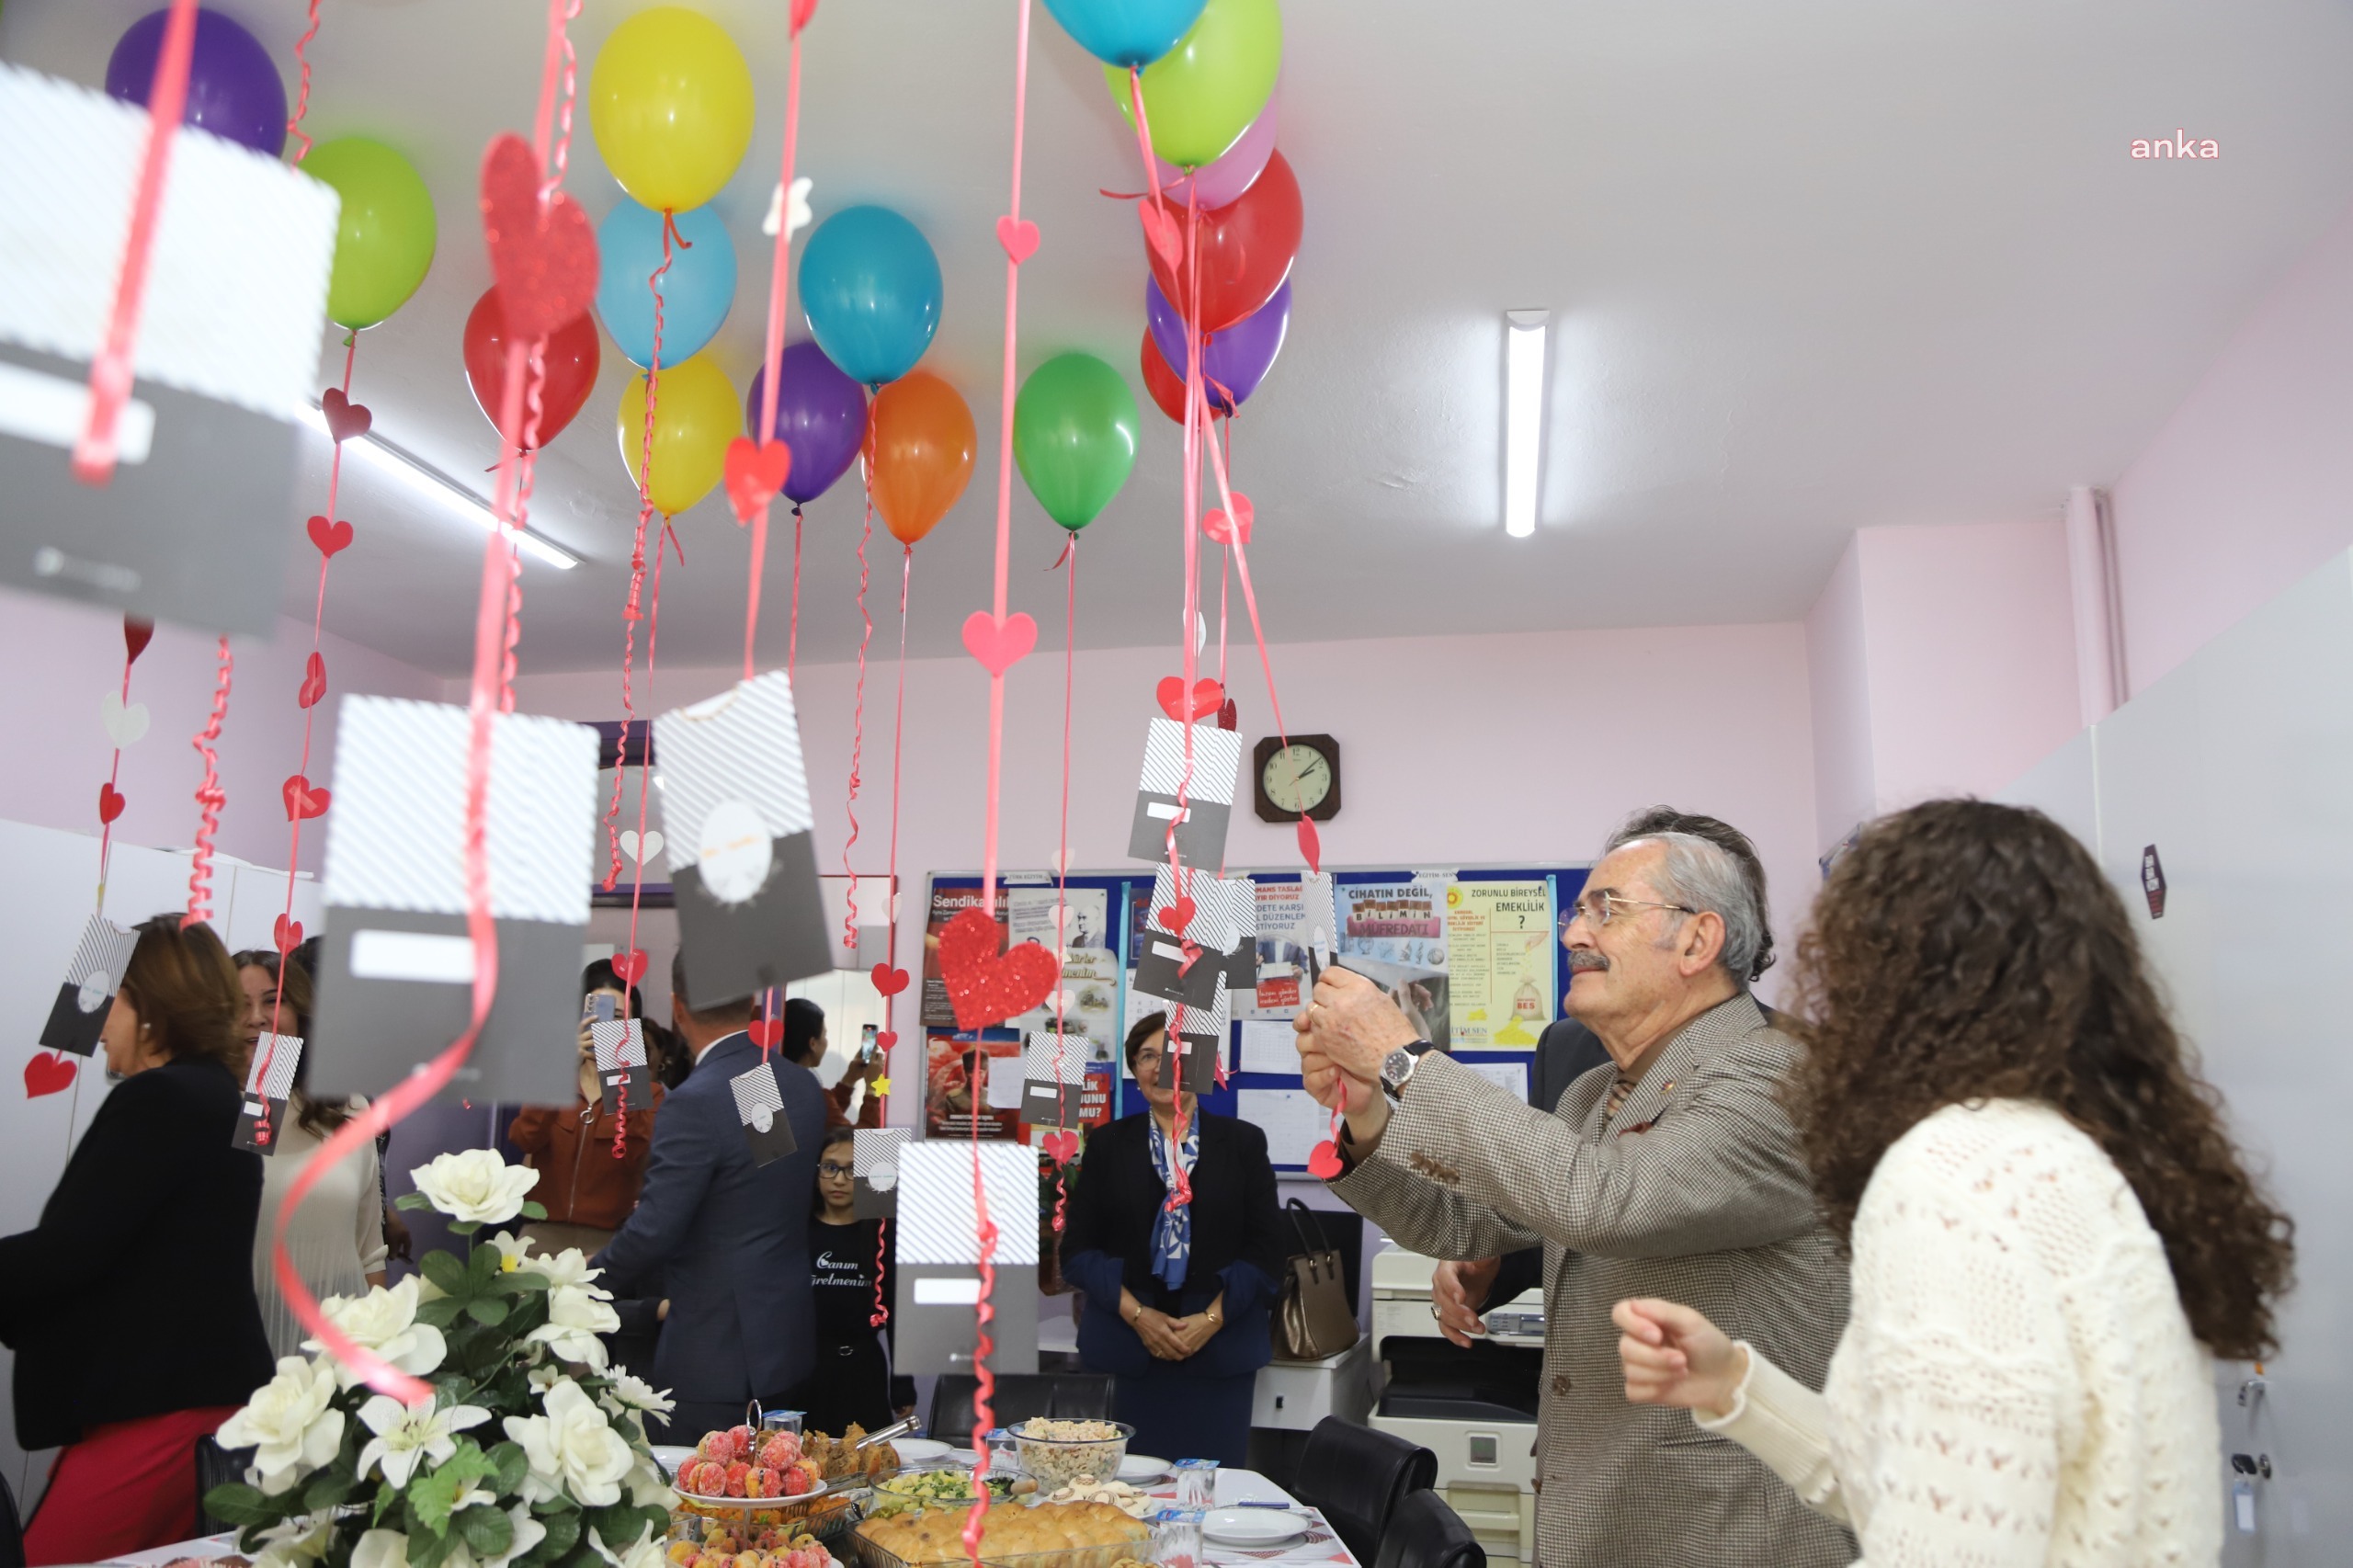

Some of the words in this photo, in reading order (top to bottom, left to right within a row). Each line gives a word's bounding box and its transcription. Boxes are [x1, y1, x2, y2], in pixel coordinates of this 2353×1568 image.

[1348, 887, 1393, 899] CİHATIN
[1397, 885, 1433, 899] DEĞİL,
[1472, 889, 1508, 897] ZORUNLU
[1510, 887, 1546, 897] BİREYSEL
[1279, 903, 1304, 912] KARŞI
[1495, 900, 1545, 912] EMEKLİLİK
[1356, 910, 1431, 921] BİLİMİN
[1256, 922, 1295, 931] STİYORUZ
[1518, 915, 1525, 929] ?
[1360, 922, 1428, 936] MÜFREDATI
[1082, 1079, 1098, 1091] LİK
[1080, 1094, 1106, 1104] UNU
[816, 1251, 858, 1270] Canım
